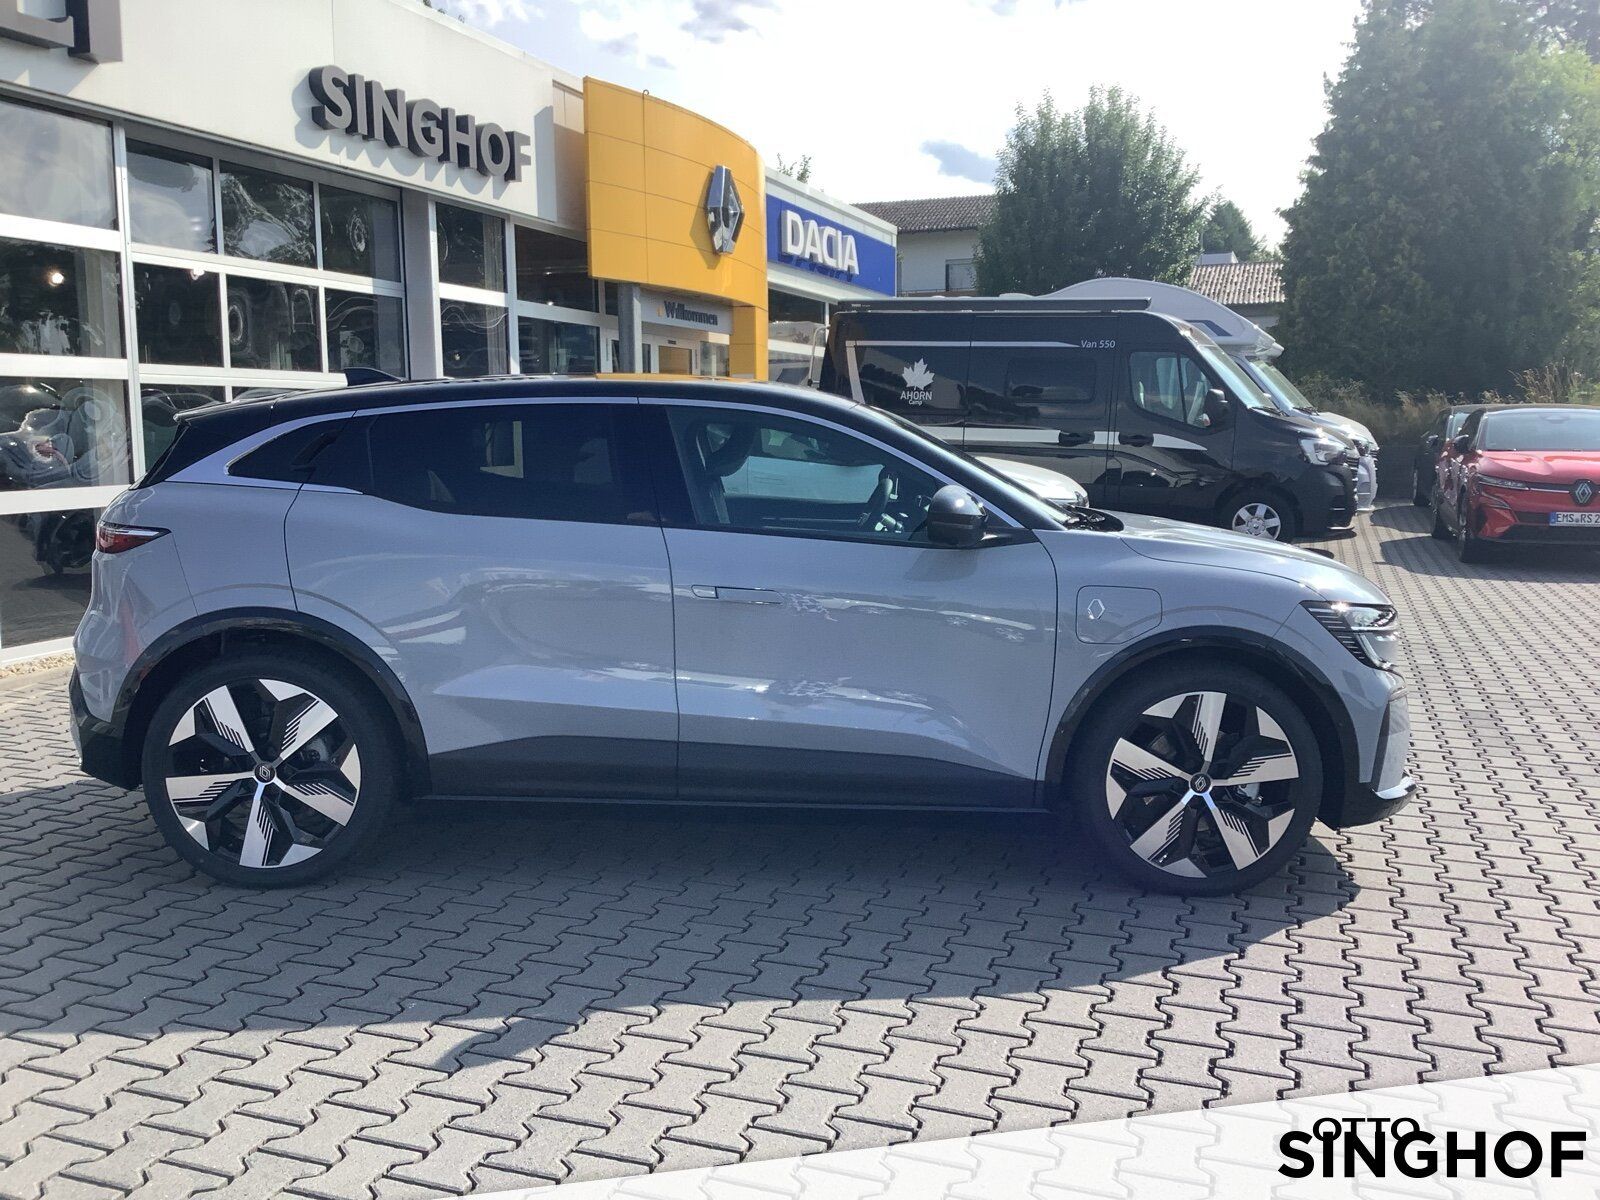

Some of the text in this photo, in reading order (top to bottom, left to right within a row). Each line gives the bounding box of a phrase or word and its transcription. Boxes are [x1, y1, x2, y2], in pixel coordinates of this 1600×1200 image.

[309, 65, 532, 182] SINGHOF
[781, 209, 860, 275] DACIA
[1081, 339, 1116, 348] Van 550
[900, 390, 932, 400] AHORN
[1556, 513, 1574, 523] EMS
[1580, 513, 1592, 524] RS
